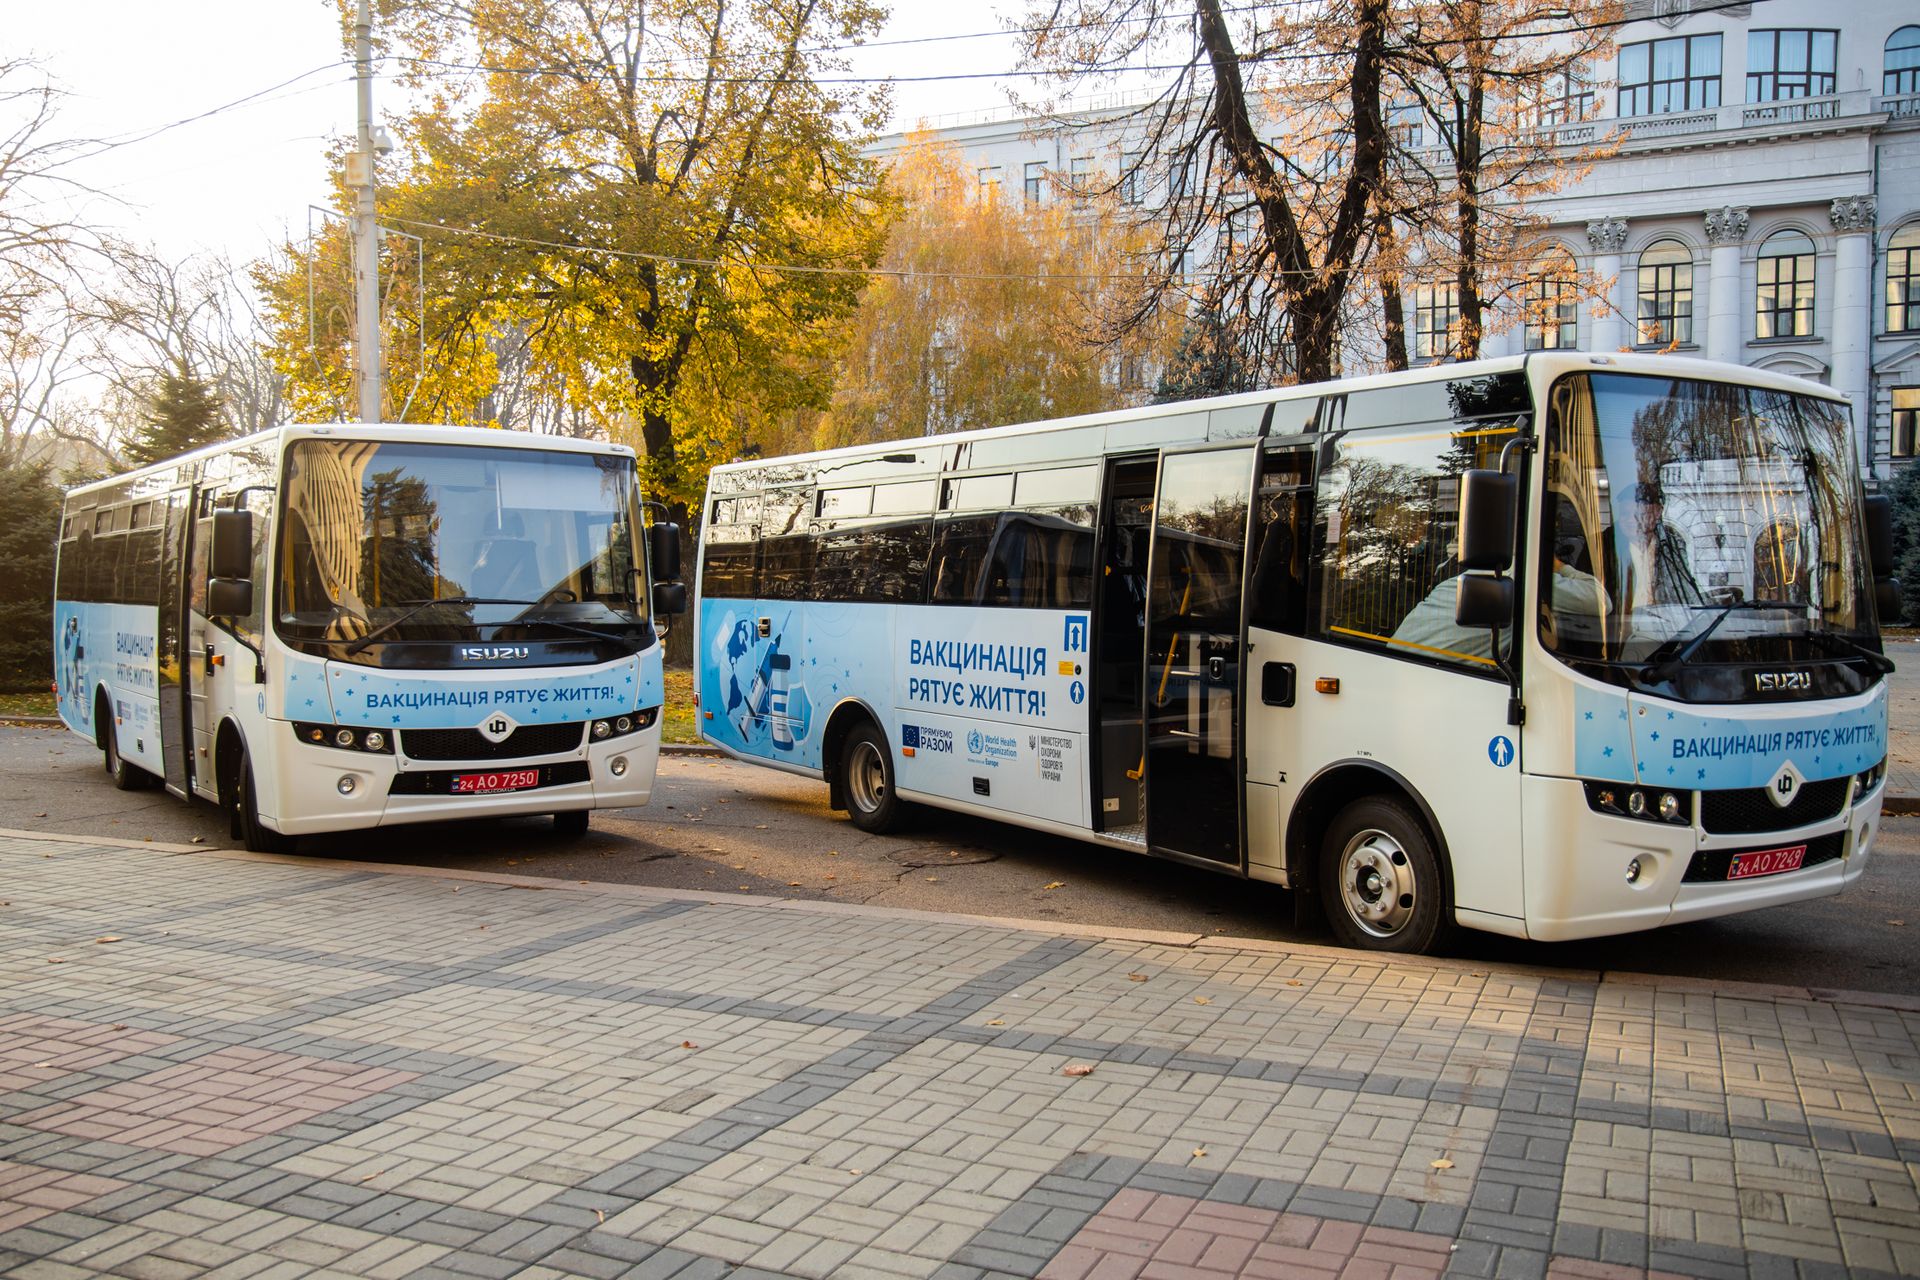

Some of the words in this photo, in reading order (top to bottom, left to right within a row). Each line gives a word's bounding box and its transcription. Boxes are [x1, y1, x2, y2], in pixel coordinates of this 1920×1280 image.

[461, 647, 529, 661] ISUZU
[910, 639, 1046, 681] ВАКЦИНАЦІЯ
[1754, 671, 1811, 692] ISUZU
[366, 690, 489, 710] ВАКЦИНАЦІЯ
[494, 688, 549, 704] РЯТУЄ
[552, 686, 615, 702] ЖИТТЯ!
[910, 677, 965, 706] РЯТУЄ
[969, 683, 1046, 717] ЖИТТЯ!
[920, 726, 953, 739] ПРЯМУЄМО
[985, 735, 1000, 744] World
[1000, 736, 1017, 747] Health
[920, 736, 953, 754] РАЗОМ
[985, 744, 1017, 757] Organization
[1672, 732, 1781, 760] ВАКЦИНАЦІЯ
[1785, 729, 1830, 750] РЯТУЄ
[1832, 724, 1876, 746] ЖИТТЯ!
[985, 757, 999, 767] Europe
[460, 780, 473, 790] 24
[477, 775, 497, 788] AO
[502, 772, 534, 786] 7250
[1736, 861, 1750, 876] 24
[1750, 855, 1771, 873] AO
[1772, 849, 1802, 870] 7249
